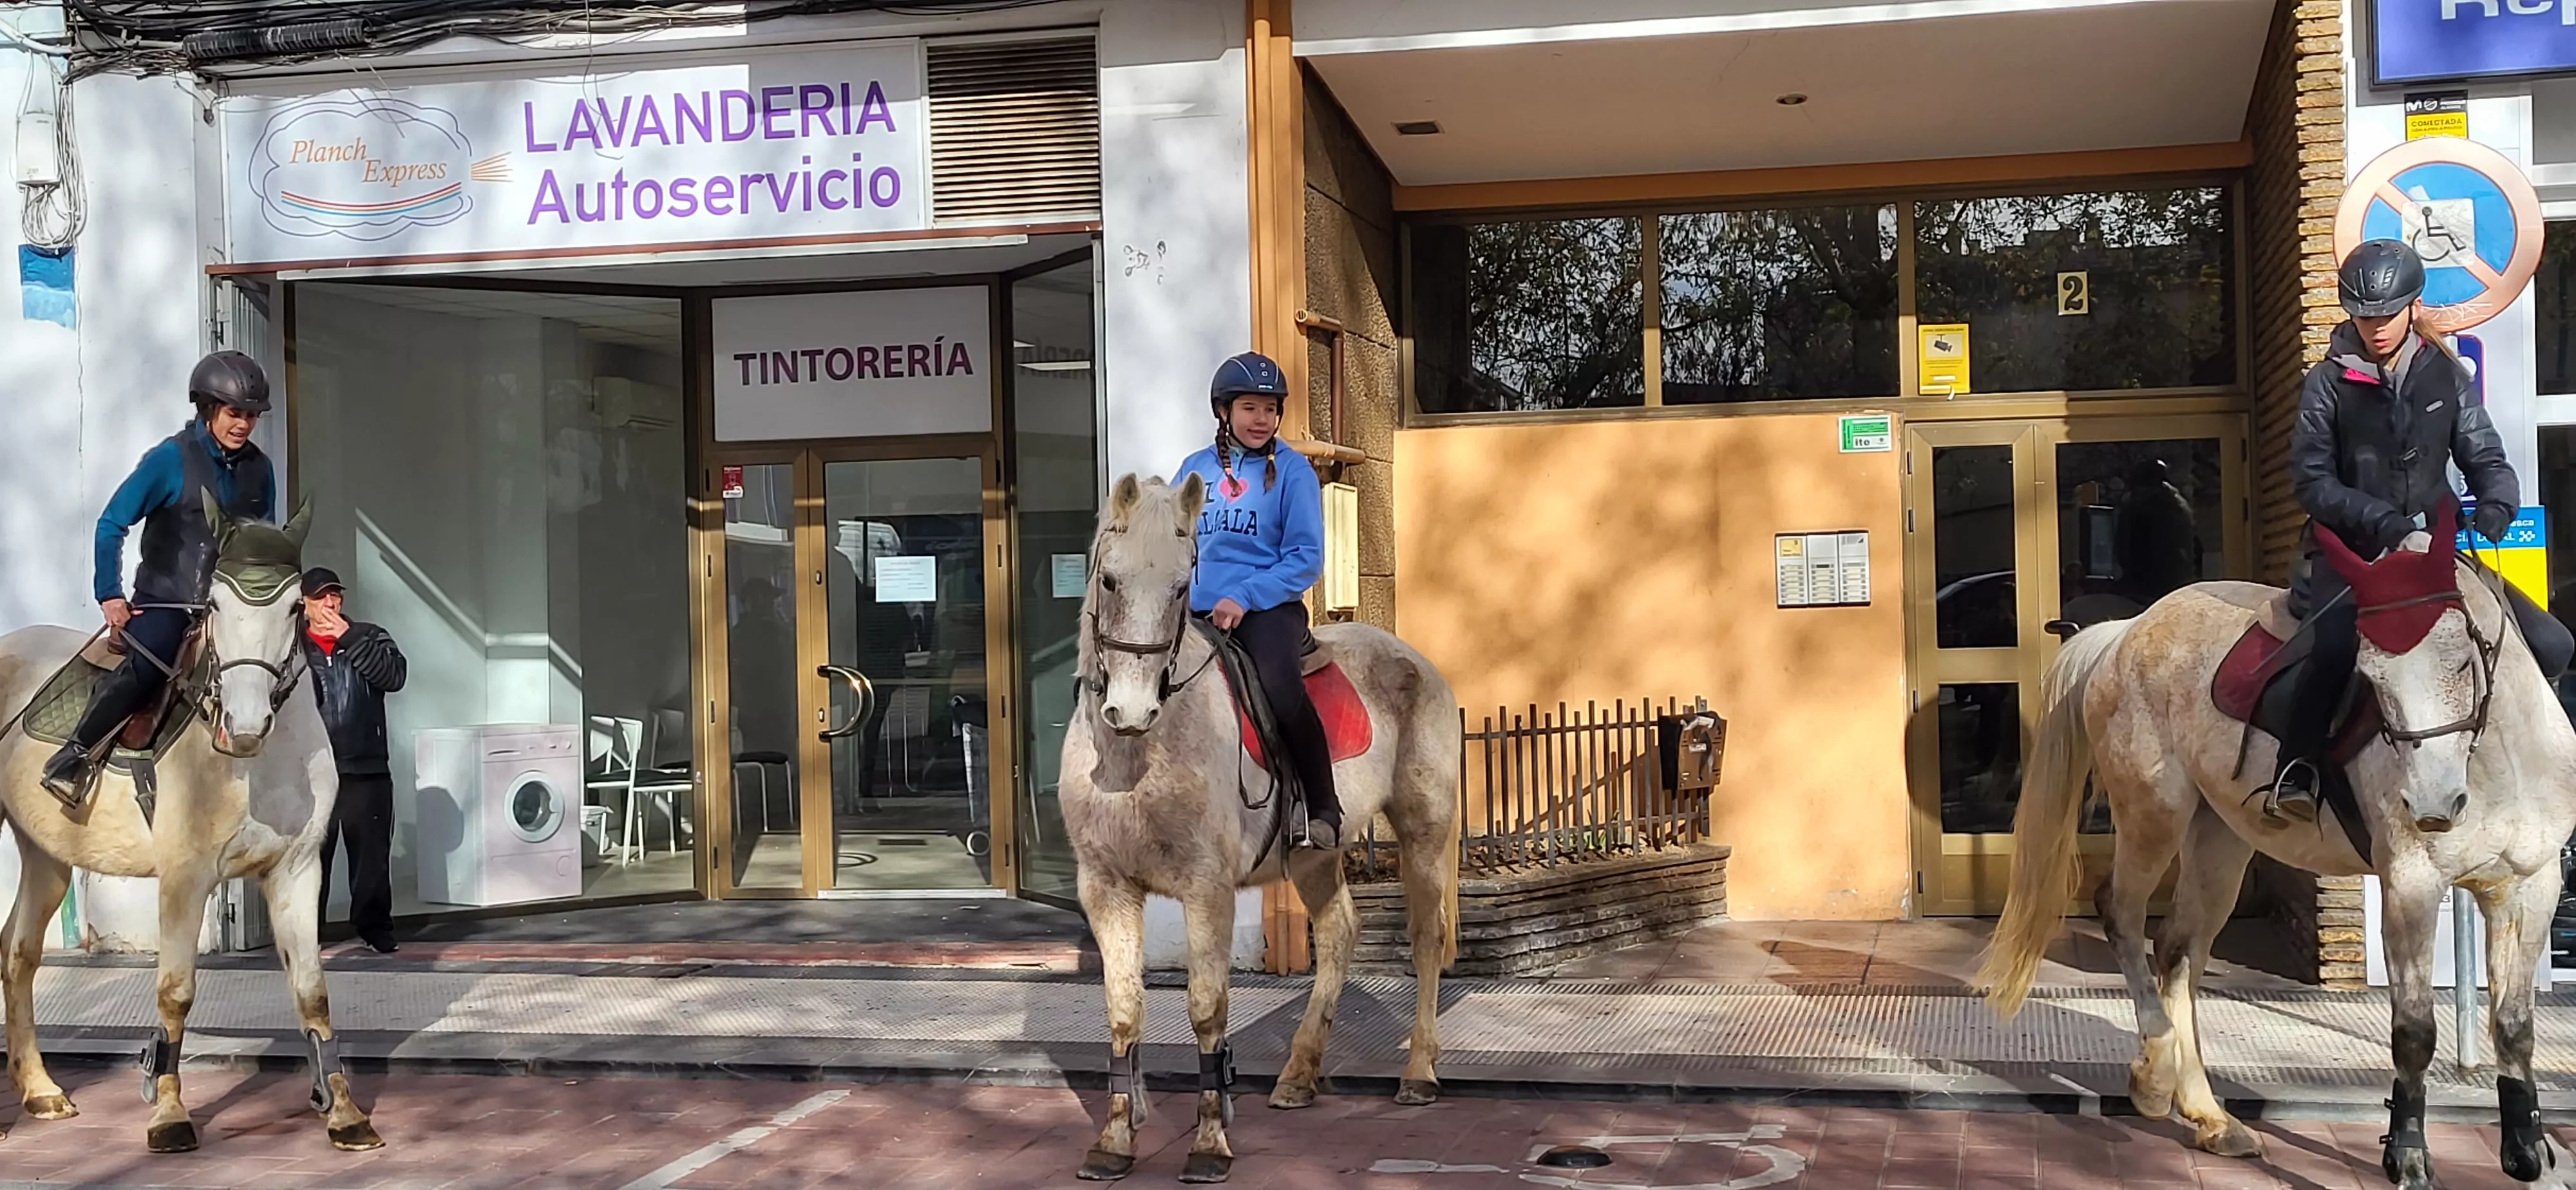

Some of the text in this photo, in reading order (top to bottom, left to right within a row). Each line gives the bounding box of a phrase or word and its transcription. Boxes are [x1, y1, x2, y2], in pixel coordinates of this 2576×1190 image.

[524, 80, 896, 153] LAVANDERIA
[289, 137, 368, 165] Planch
[362, 158, 447, 187] Express
[527, 153, 901, 225] Autoservicio
[2063, 275, 2084, 310] 2
[734, 337, 973, 386] TINTORERÍA
[1855, 438, 1870, 446] ite
